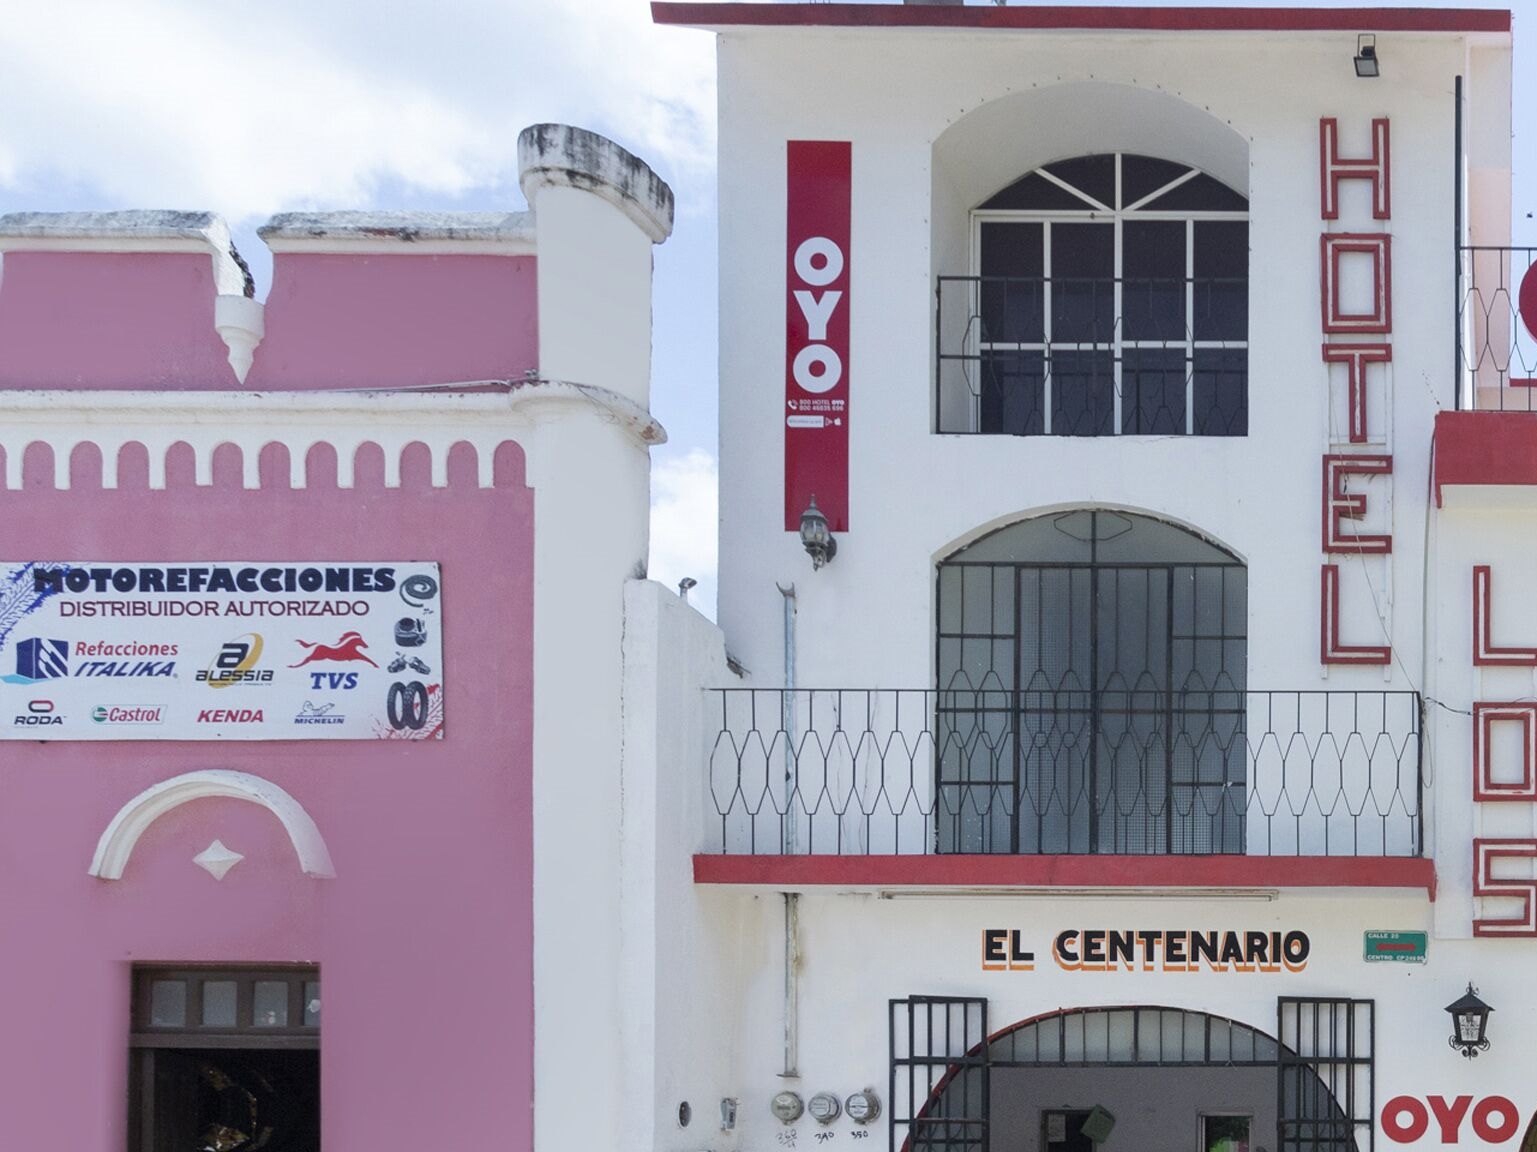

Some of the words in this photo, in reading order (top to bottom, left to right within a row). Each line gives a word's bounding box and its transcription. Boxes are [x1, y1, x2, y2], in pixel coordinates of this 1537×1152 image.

[793, 236, 844, 393] OYO
[1320, 117, 1393, 665] HOTEL
[33, 568, 396, 593] MOTOREFACCIONES
[60, 601, 219, 617] DISTRIBUIDOR
[224, 600, 370, 616] AUTORIZADO
[75, 641, 178, 656] Refacciones
[74, 662, 177, 678] ITALIKA
[310, 672, 359, 690] TVS
[14, 715, 63, 725] RODA
[109, 707, 161, 722] Castrol
[197, 710, 264, 723] KENDA
[982, 930, 1035, 971] EL
[1052, 930, 1311, 973] CENTENARIO
[1381, 1095, 1520, 1144] OYO
